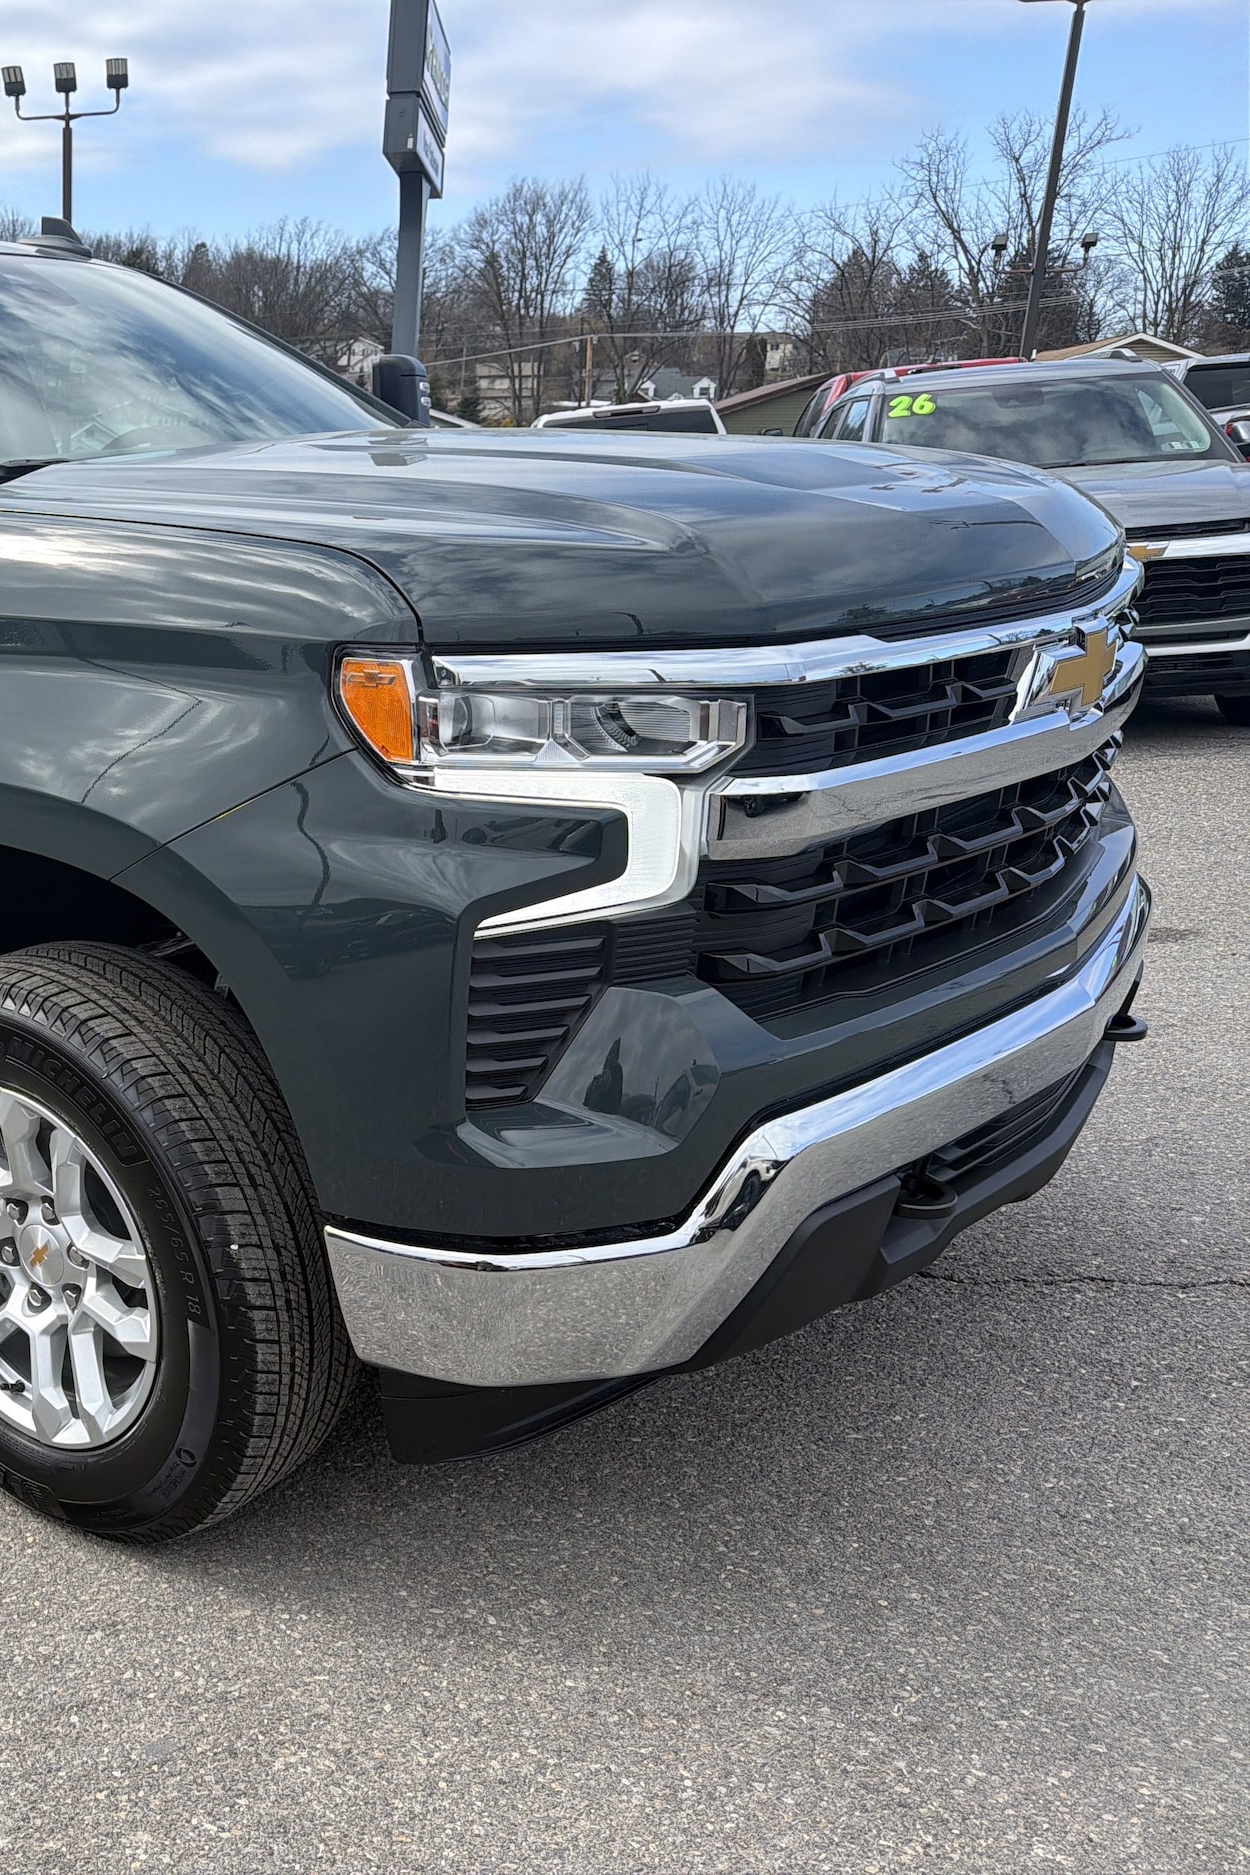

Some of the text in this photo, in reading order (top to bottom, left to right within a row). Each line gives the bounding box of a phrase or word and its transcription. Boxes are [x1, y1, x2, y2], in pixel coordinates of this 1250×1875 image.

[888, 393, 936, 418] 26
[7, 1036, 140, 1158] MICHELIN
[148, 1187, 202, 1316] 265/65 R 18
